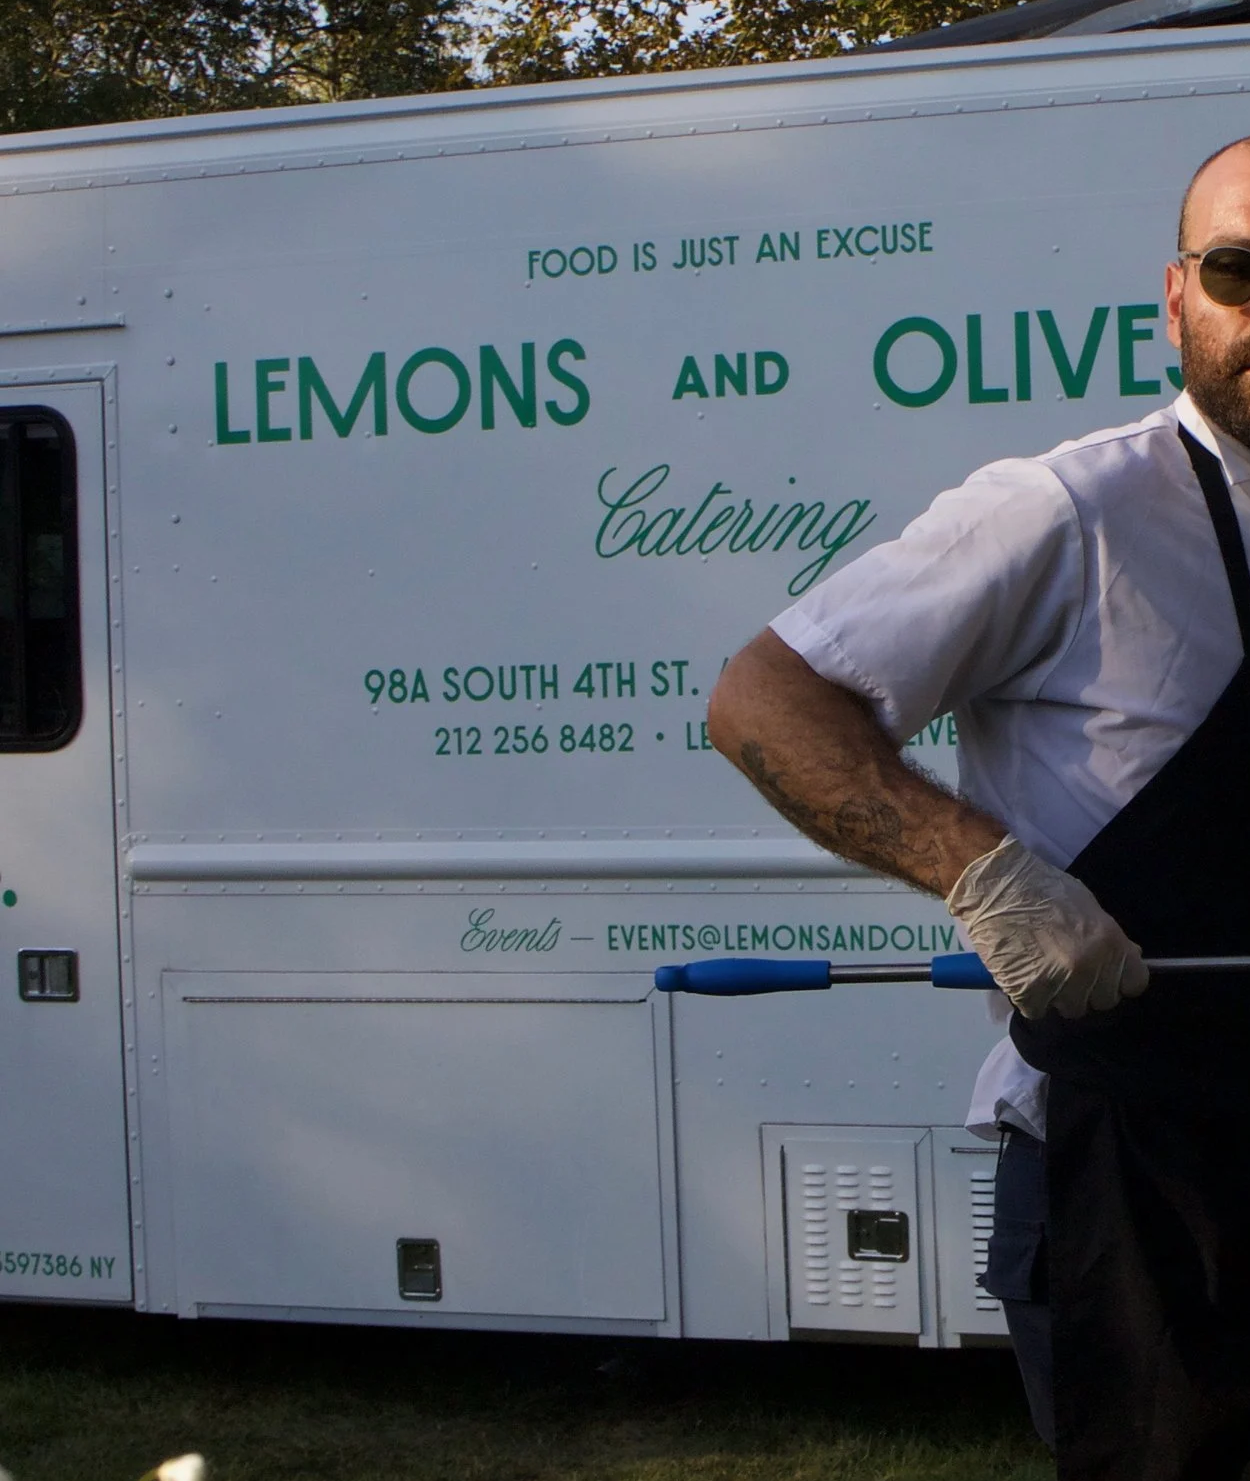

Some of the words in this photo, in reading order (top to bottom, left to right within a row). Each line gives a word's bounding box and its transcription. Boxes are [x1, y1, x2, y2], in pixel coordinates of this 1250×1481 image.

[528, 244, 618, 280] FOOD
[633, 241, 657, 273] IS
[672, 235, 740, 270] JUST
[755, 231, 801, 264] AN
[816, 221, 933, 259] EXCUSE
[214, 337, 591, 446] LEMONS
[671, 350, 790, 400] AND
[872, 303, 1184, 408] OLIVE
[594, 463, 878, 597] Catering
[364, 668, 430, 704] 98A
[442, 663, 559, 703] SOUTH
[572, 661, 636, 699] 4TH
[650, 659, 699, 697] ST.
[434, 726, 483, 756] 212
[494, 724, 549, 755] 256
[559, 722, 634, 753] 8482
[460, 907, 563, 952] Events
[607, 924, 965, 952] EVENTS@LEMONSANDOLIV
[0, 1251, 83, 1278] 597386
[90, 1256, 116, 1279] NY
